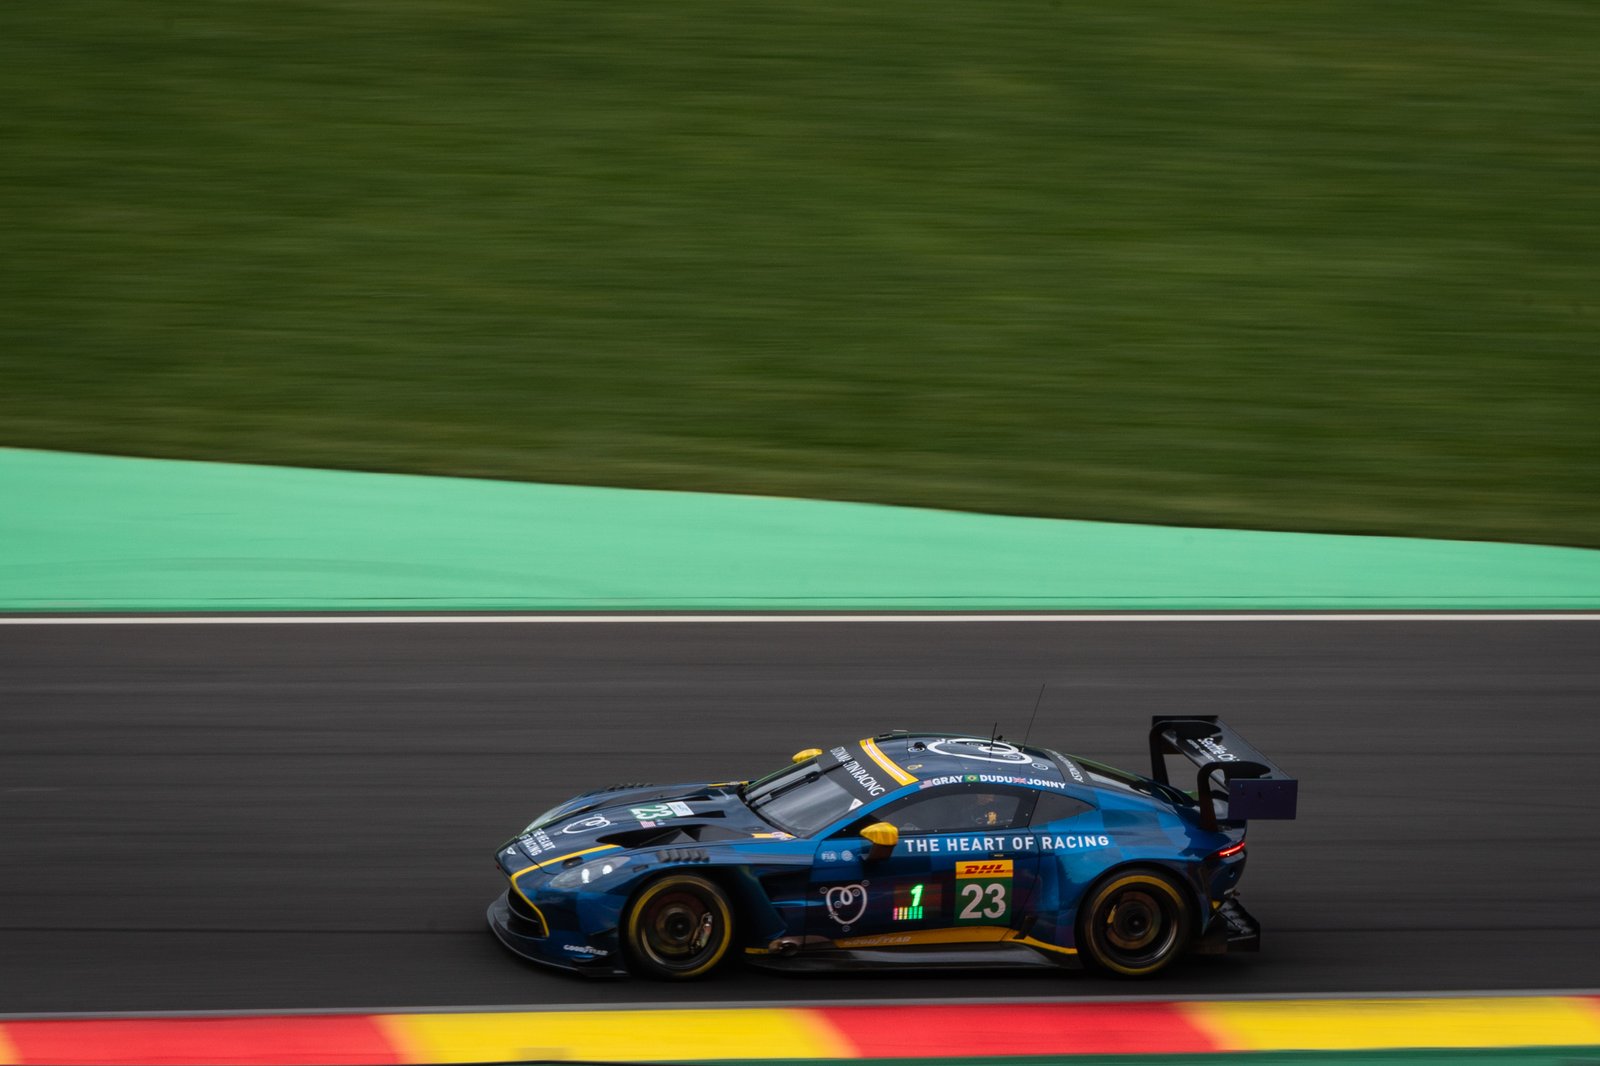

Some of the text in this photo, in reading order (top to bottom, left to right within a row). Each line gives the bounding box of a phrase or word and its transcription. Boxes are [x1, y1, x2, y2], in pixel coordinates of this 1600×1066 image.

[851, 769, 886, 796] RACING
[932, 775, 963, 786] GRAY
[979, 774, 1014, 784] DUDU
[1027, 778, 1066, 789] JONNY
[630, 804, 674, 820] 23
[904, 836, 1109, 852] THE HEART OF RACING
[964, 864, 1006, 875] DHL
[910, 884, 924, 907] 1
[958, 883, 1007, 920] 23
